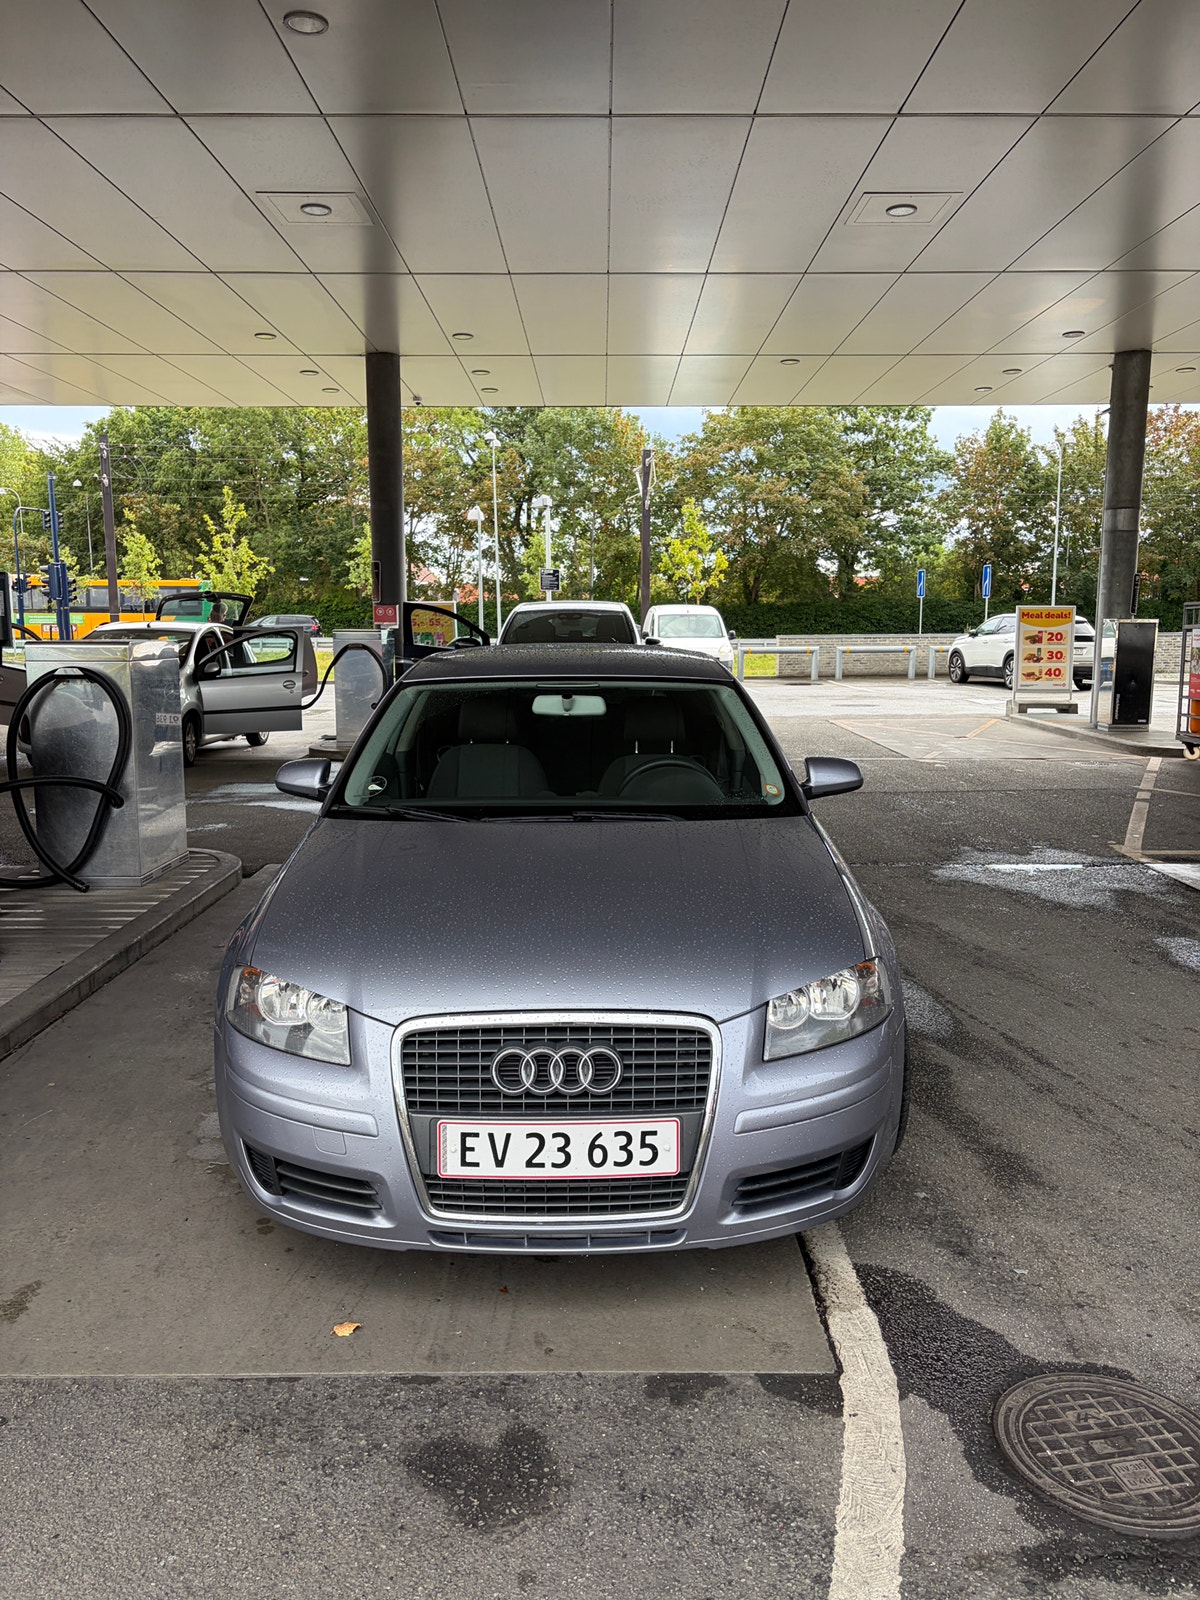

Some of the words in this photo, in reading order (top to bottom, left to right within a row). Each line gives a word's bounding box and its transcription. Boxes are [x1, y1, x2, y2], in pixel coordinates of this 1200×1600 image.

[1021, 611, 1043, 619] Meal
[1044, 611, 1071, 619] deals!
[460, 1132, 512, 1168] EV
[525, 1132, 572, 1169] 23
[588, 1130, 659, 1168] 635
